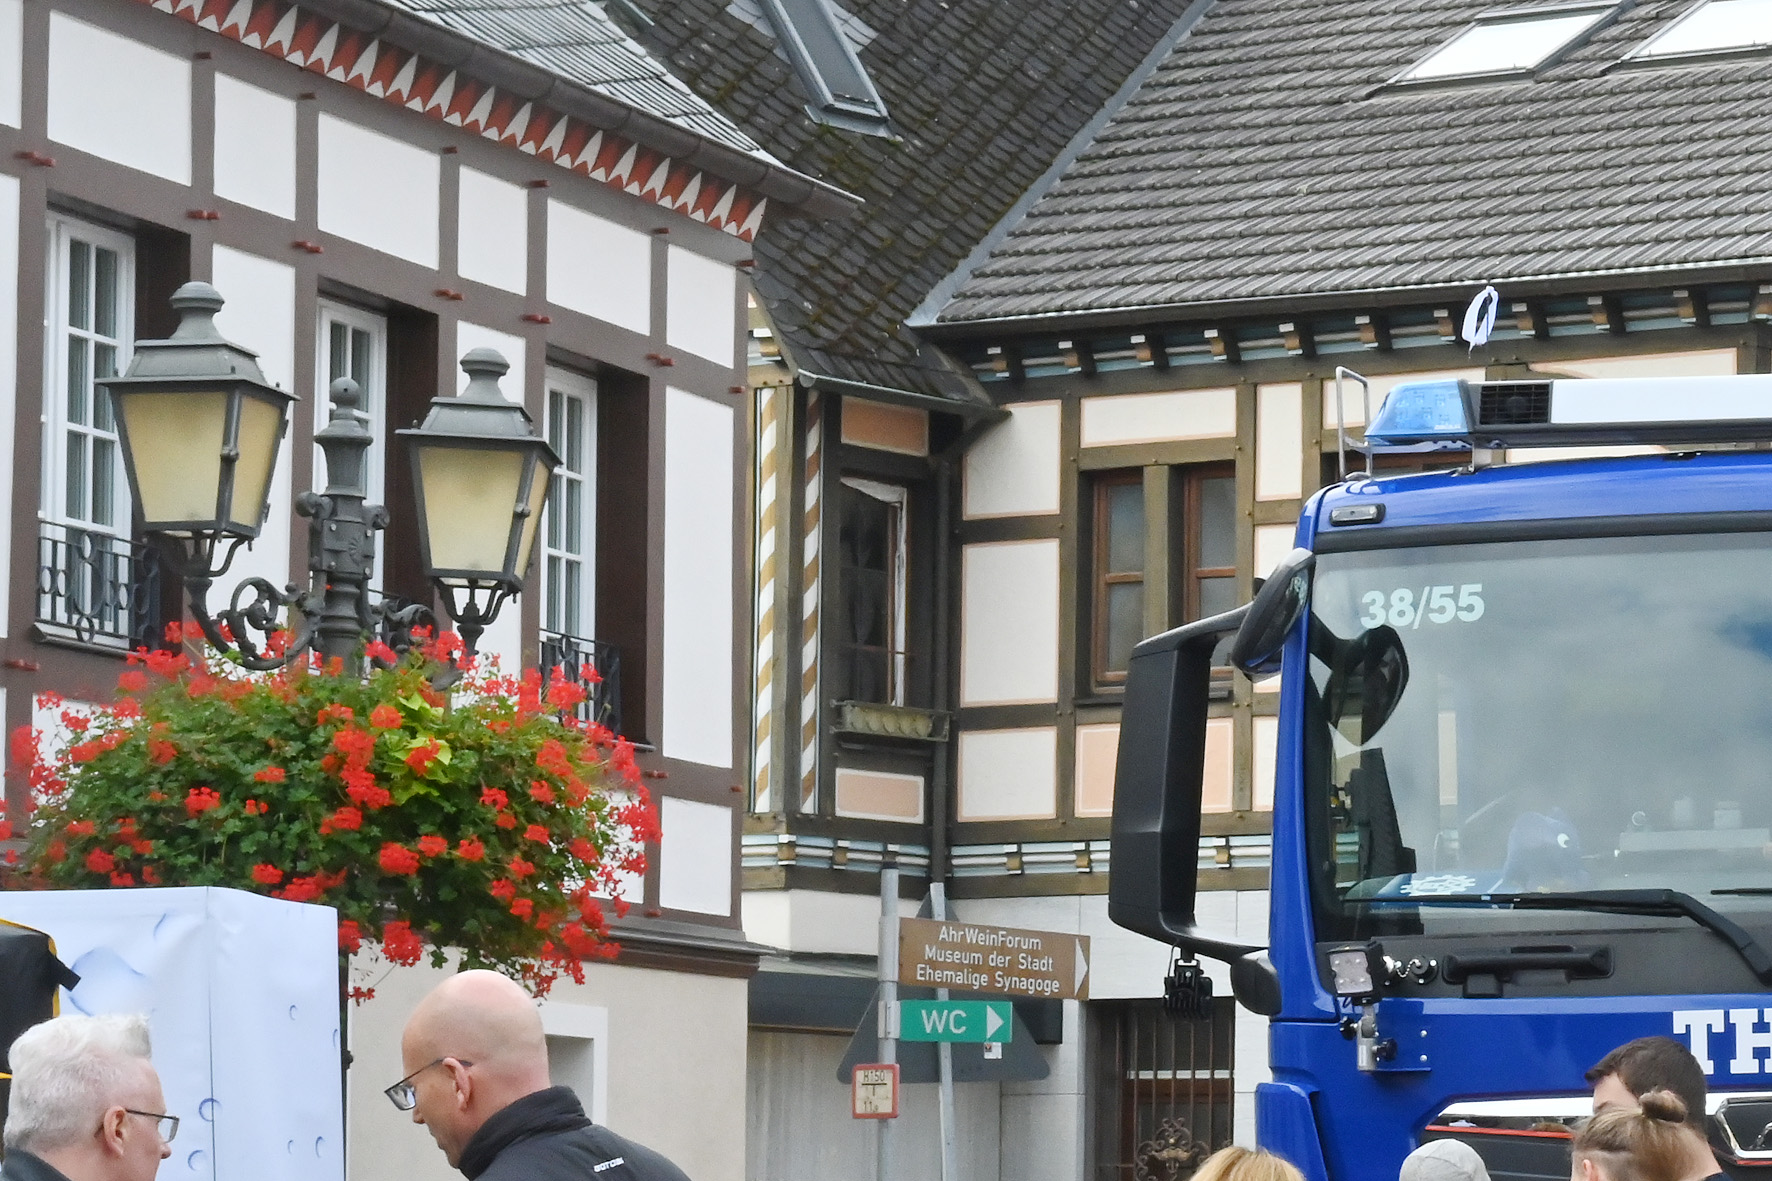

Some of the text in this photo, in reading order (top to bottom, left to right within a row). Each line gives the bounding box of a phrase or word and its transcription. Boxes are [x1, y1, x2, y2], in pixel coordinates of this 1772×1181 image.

[1360, 583, 1485, 630] 38/55
[924, 944, 1054, 973] Museum der Stadt
[916, 963, 1060, 996] Ehemalige Synagoge
[920, 1009, 968, 1034] WC
